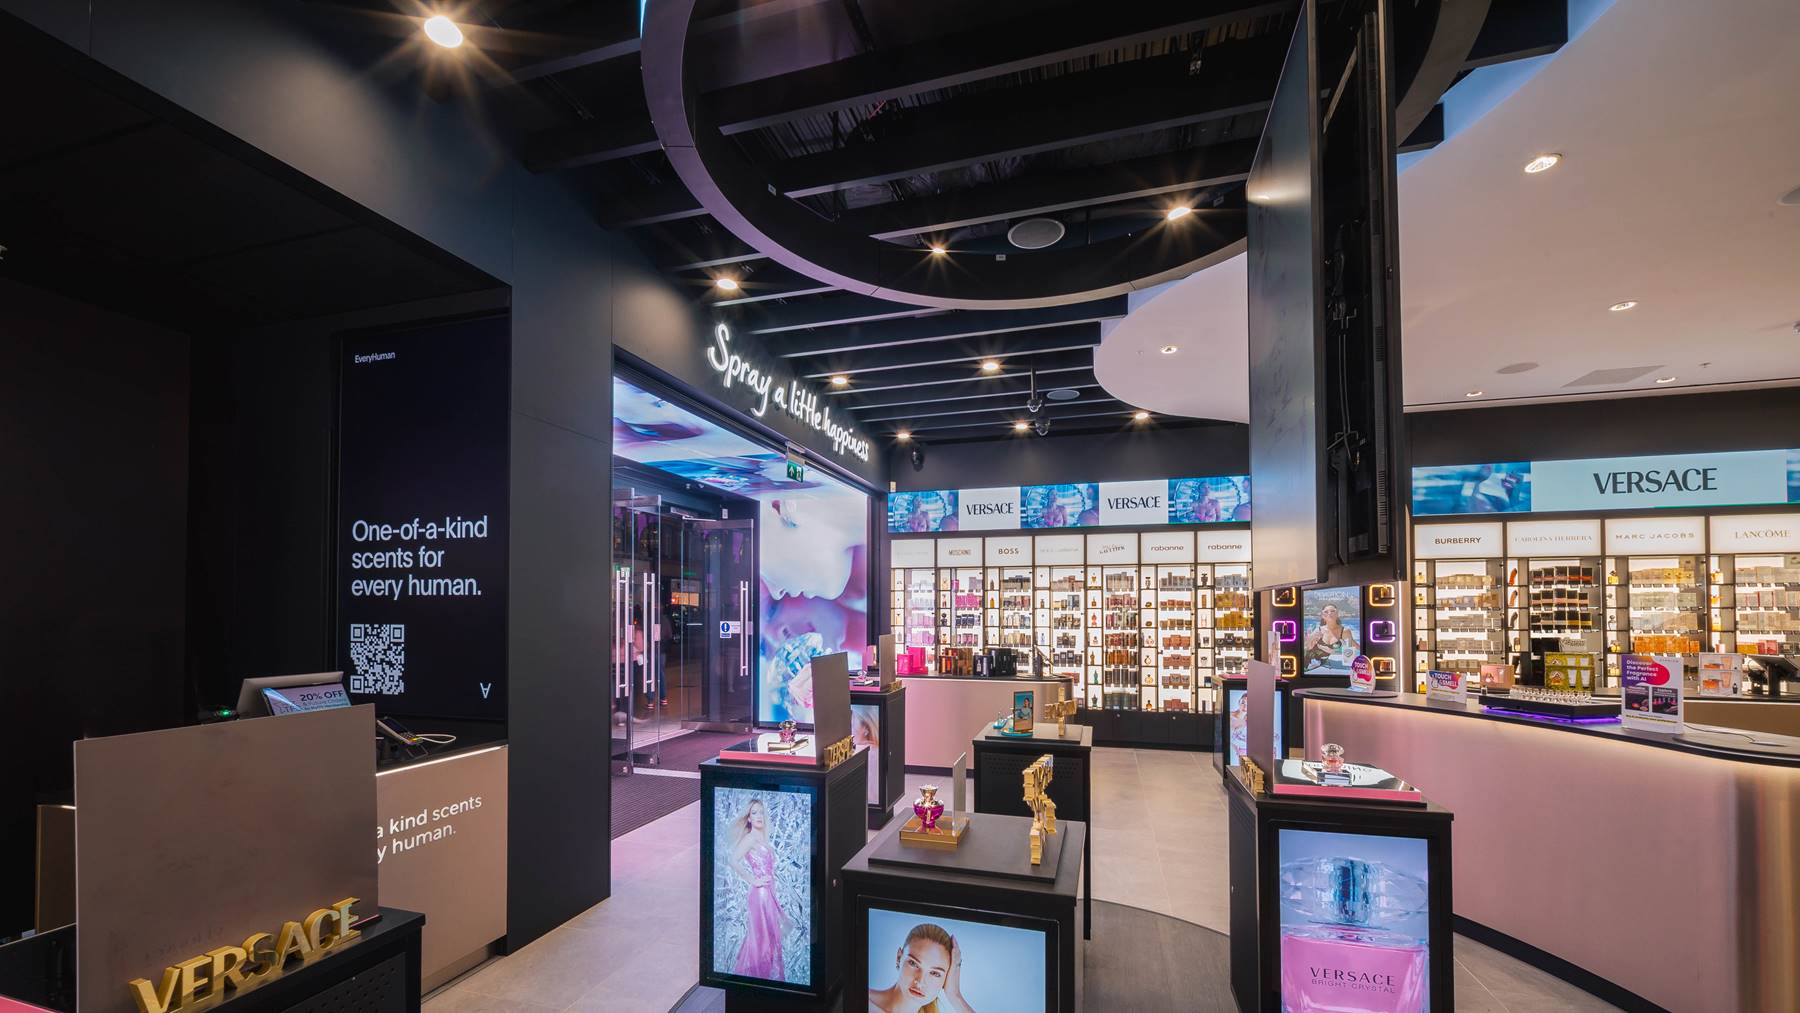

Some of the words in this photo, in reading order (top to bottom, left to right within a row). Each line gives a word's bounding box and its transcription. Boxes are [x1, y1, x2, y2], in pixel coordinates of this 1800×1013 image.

[354, 351, 396, 364] EveryHuman
[707, 323, 772, 417] Spray
[774, 386, 788, 409] a
[790, 380, 821, 430] little
[822, 406, 870, 462] happiness
[1592, 467, 1718, 495] VERSACE
[966, 503, 1014, 516] VERSACE
[1107, 496, 1161, 511] VERSACE
[352, 515, 488, 542] One-of-a-kind
[1649, 532, 1695, 540] JACOBS
[1734, 529, 1791, 539] LANCÔME
[1434, 536, 1482, 545] BURBERRY
[351, 546, 413, 569] scents
[418, 545, 445, 568] for
[351, 579, 403, 600] every
[408, 574, 482, 597] human.
[1434, 673, 1452, 681] TOUCH
[300, 693, 323, 702] 20%
[324, 689, 344, 700] OFF
[389, 808, 428, 835] kind
[432, 796, 483, 821] scents
[392, 824, 457, 855] human.
[128, 896, 361, 1013] VERSACE
[1310, 966, 1396, 987] VERSACE
[1311, 979, 1347, 987] BRIGHT
[1351, 983, 1396, 994] CRYSTAL
